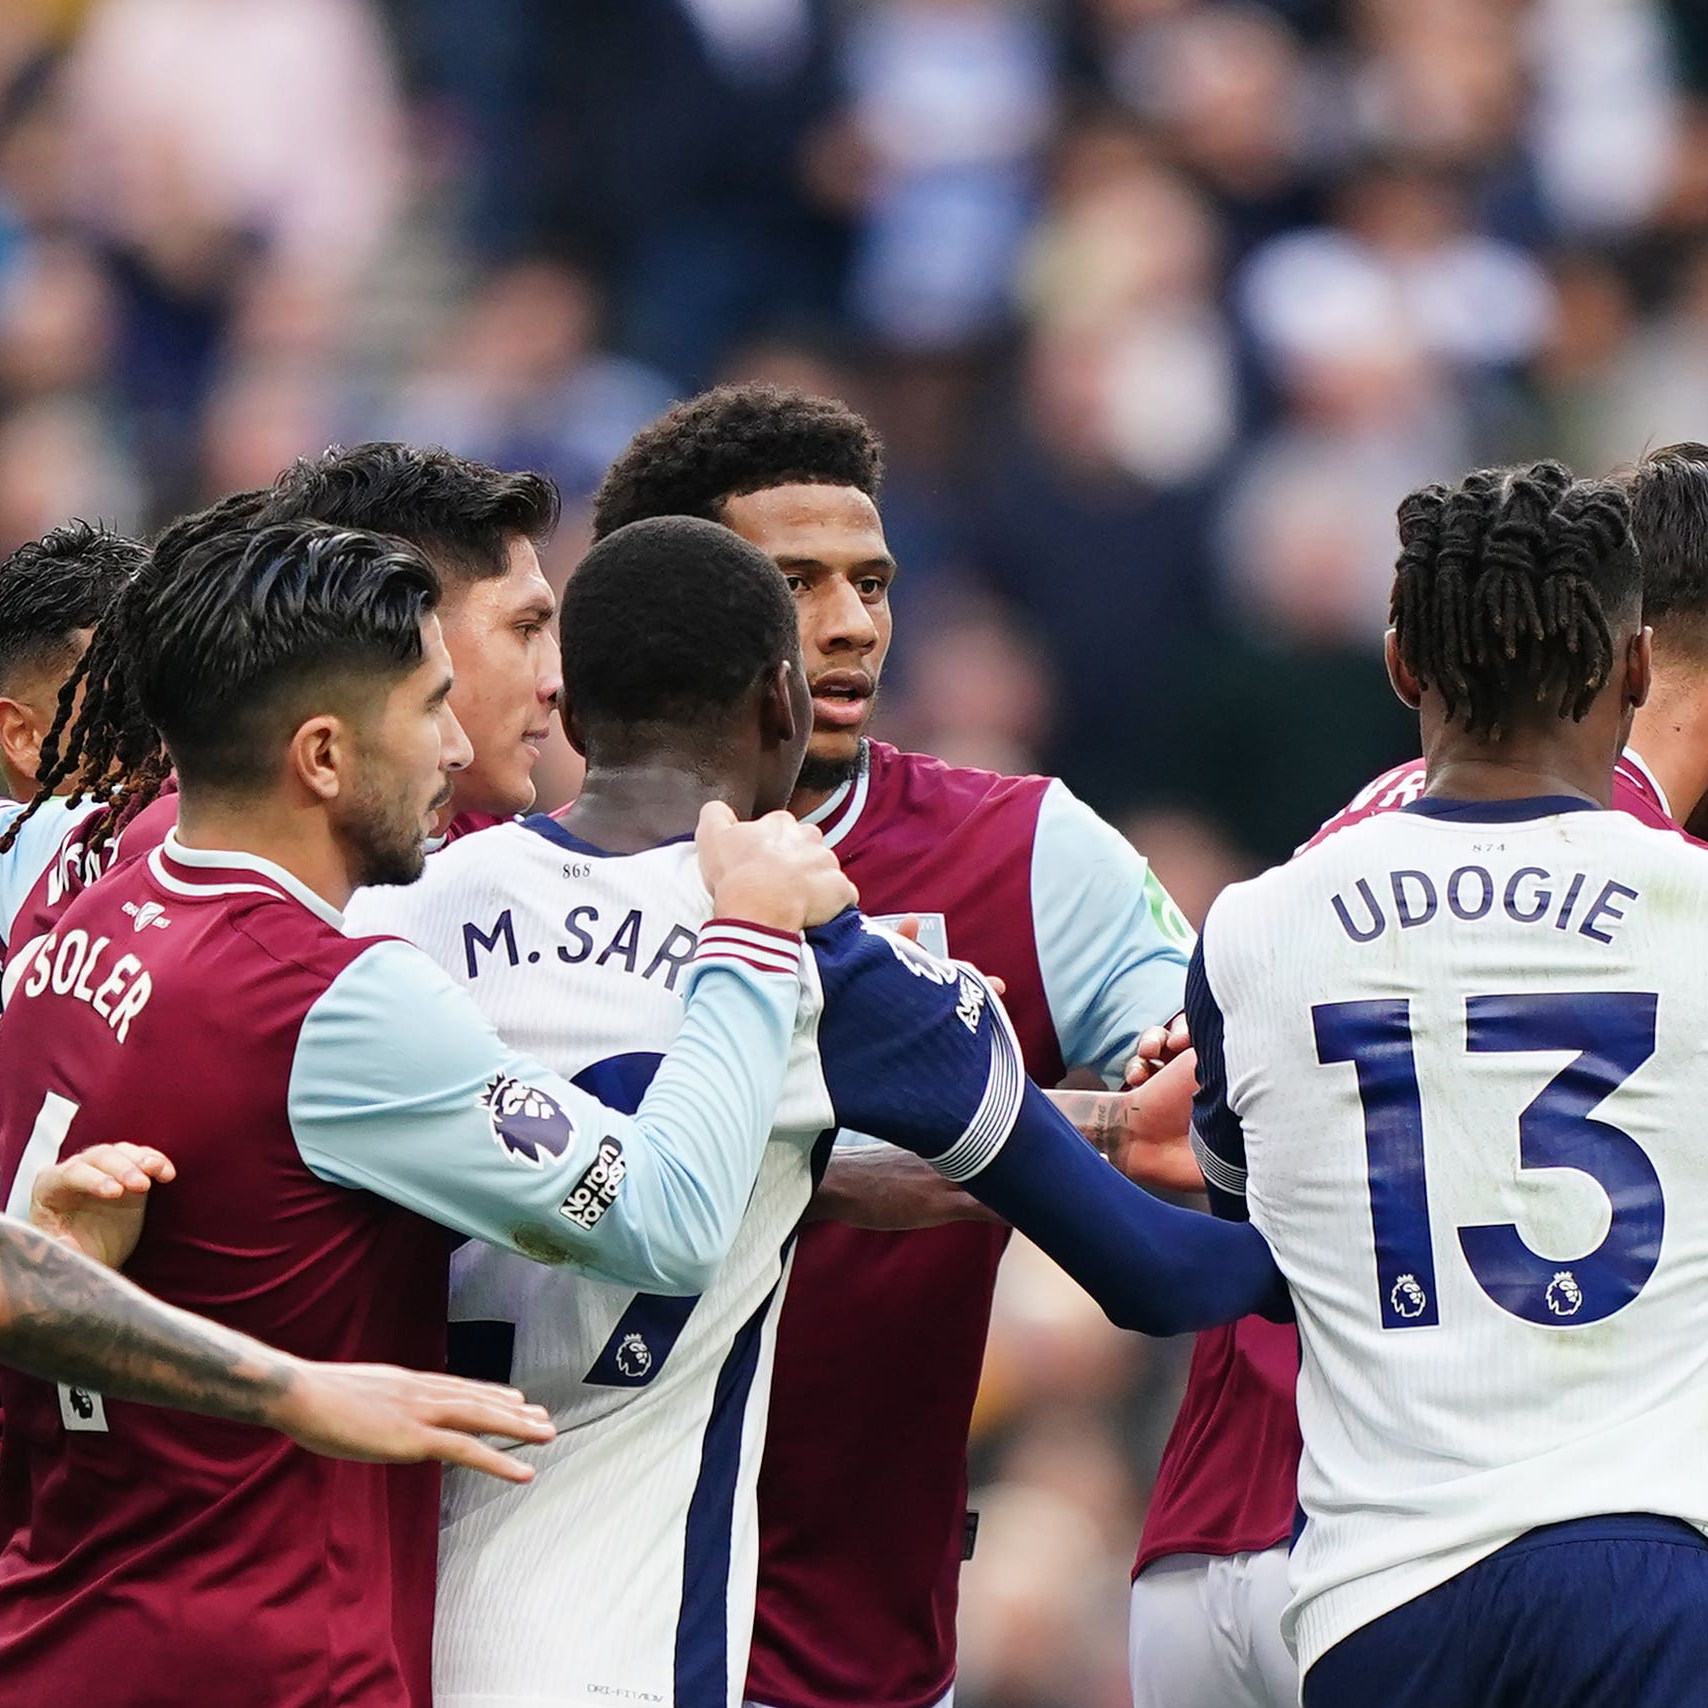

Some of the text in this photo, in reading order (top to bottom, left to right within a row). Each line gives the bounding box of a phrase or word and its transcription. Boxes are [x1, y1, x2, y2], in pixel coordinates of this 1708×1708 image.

[562, 862, 592, 880] 868
[1472, 842, 1507, 854] 874
[1331, 864, 1639, 946] UDOGIE
[25, 929, 153, 1045] SOLER
[462, 905, 699, 999] M. SAR
[1311, 991, 1667, 1331] 13
[559, 1186, 592, 1222] No
